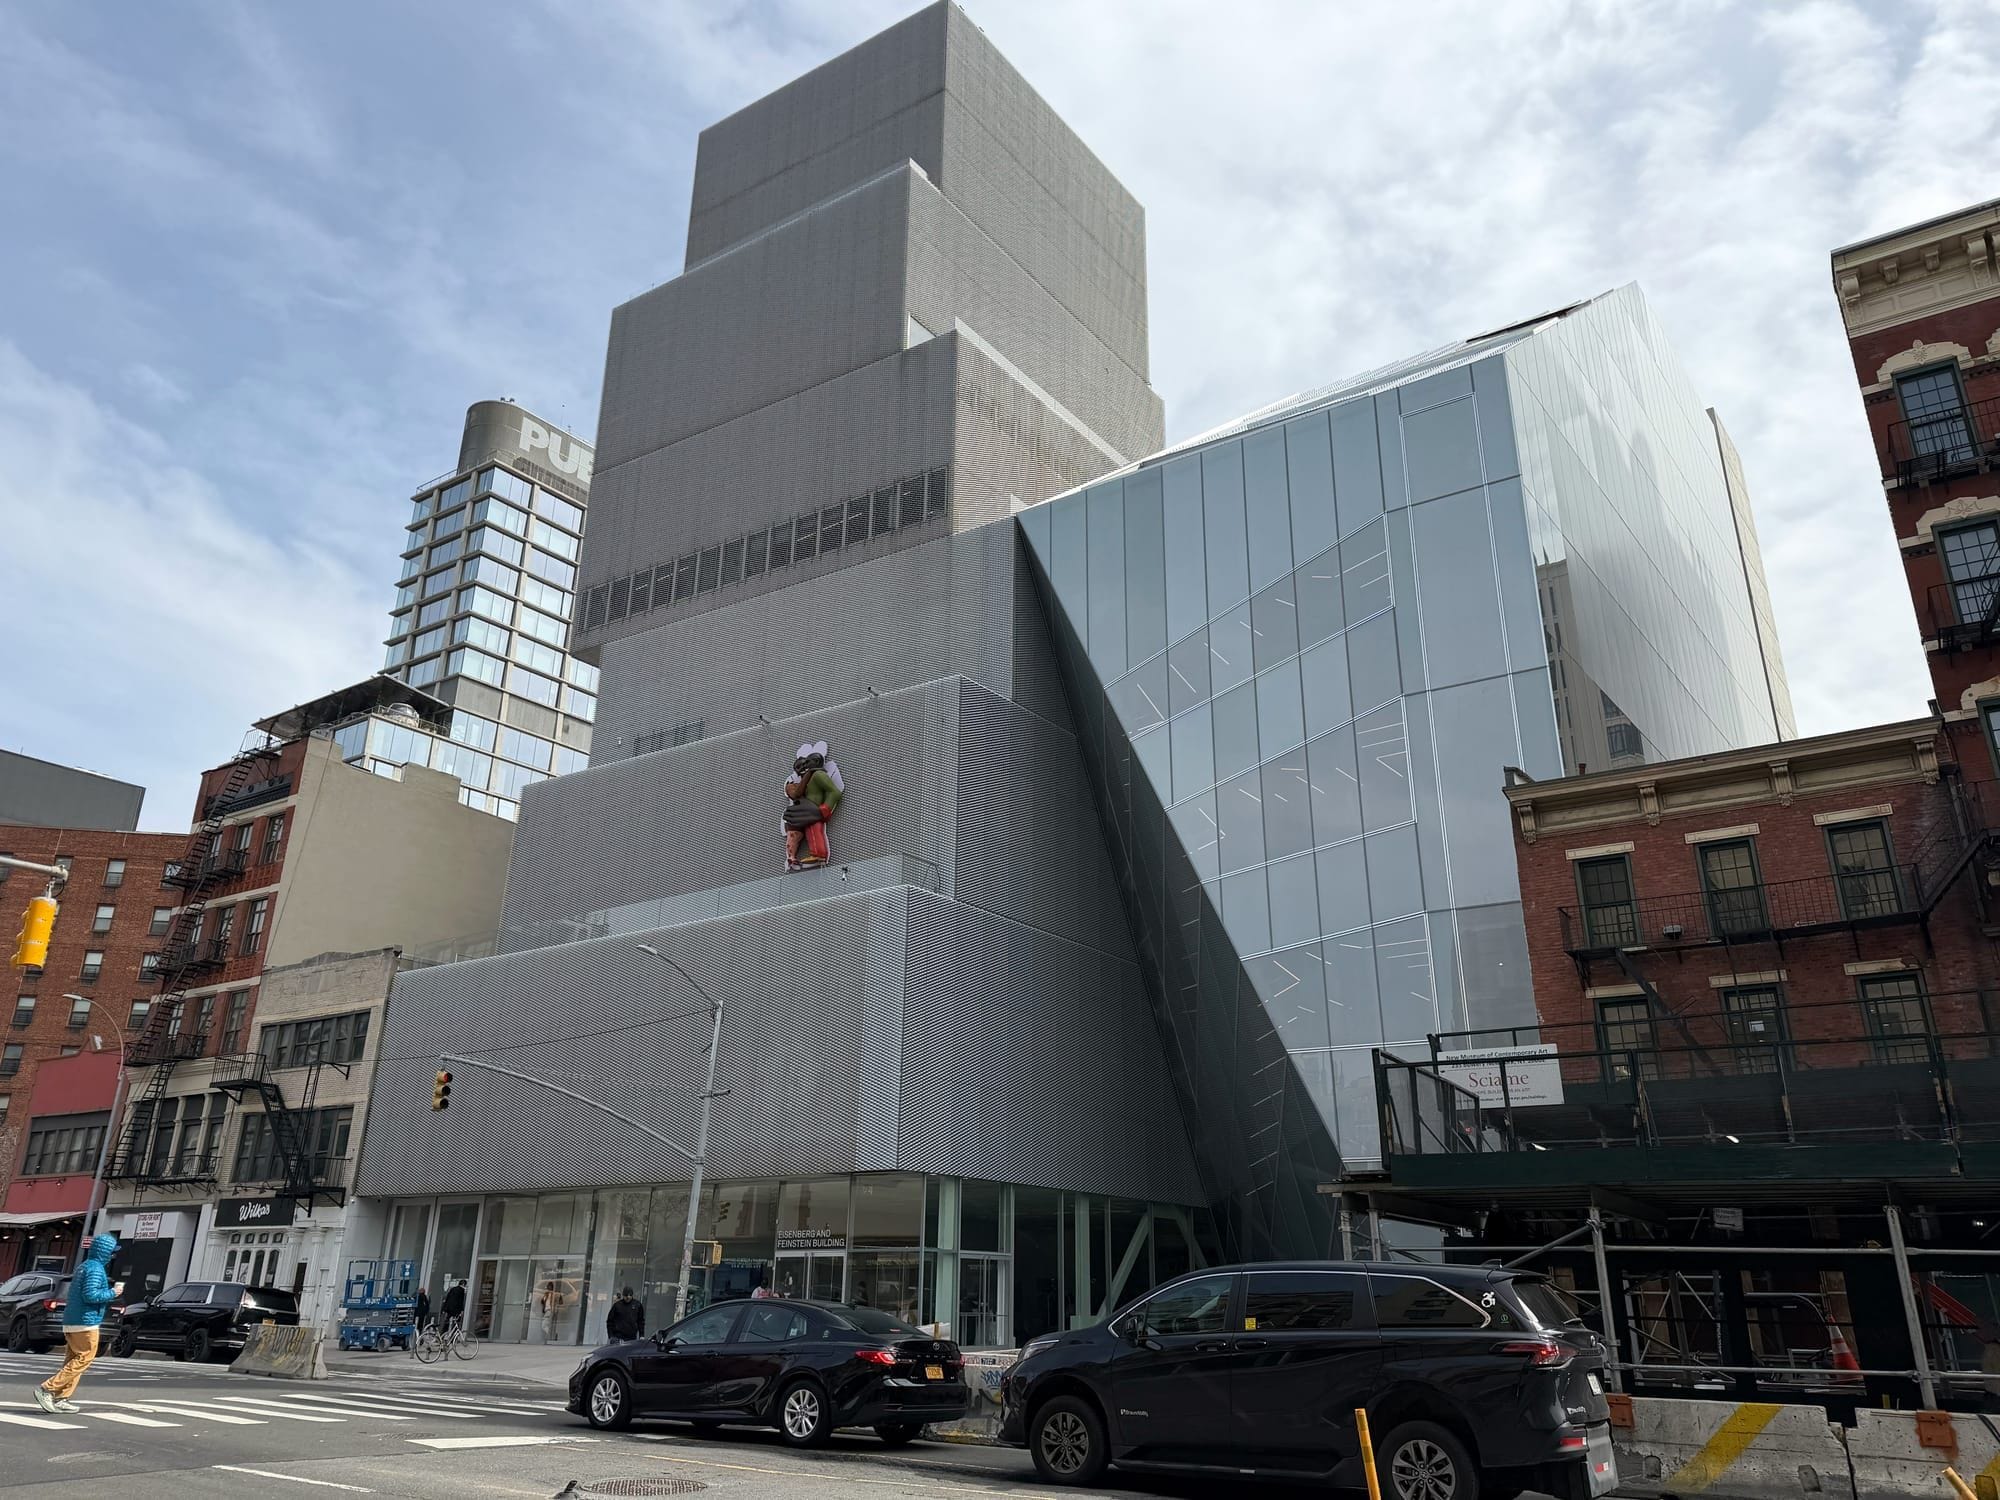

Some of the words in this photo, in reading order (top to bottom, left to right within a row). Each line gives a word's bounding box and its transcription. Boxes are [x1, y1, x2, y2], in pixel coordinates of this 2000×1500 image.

[1468, 1073, 1529, 1088] Sciame
[778, 1230, 815, 1239] EISENBERG
[816, 1229, 831, 1238] AND
[777, 1239, 811, 1248] FEINSTEIN
[812, 1239, 845, 1247] BUILDING
